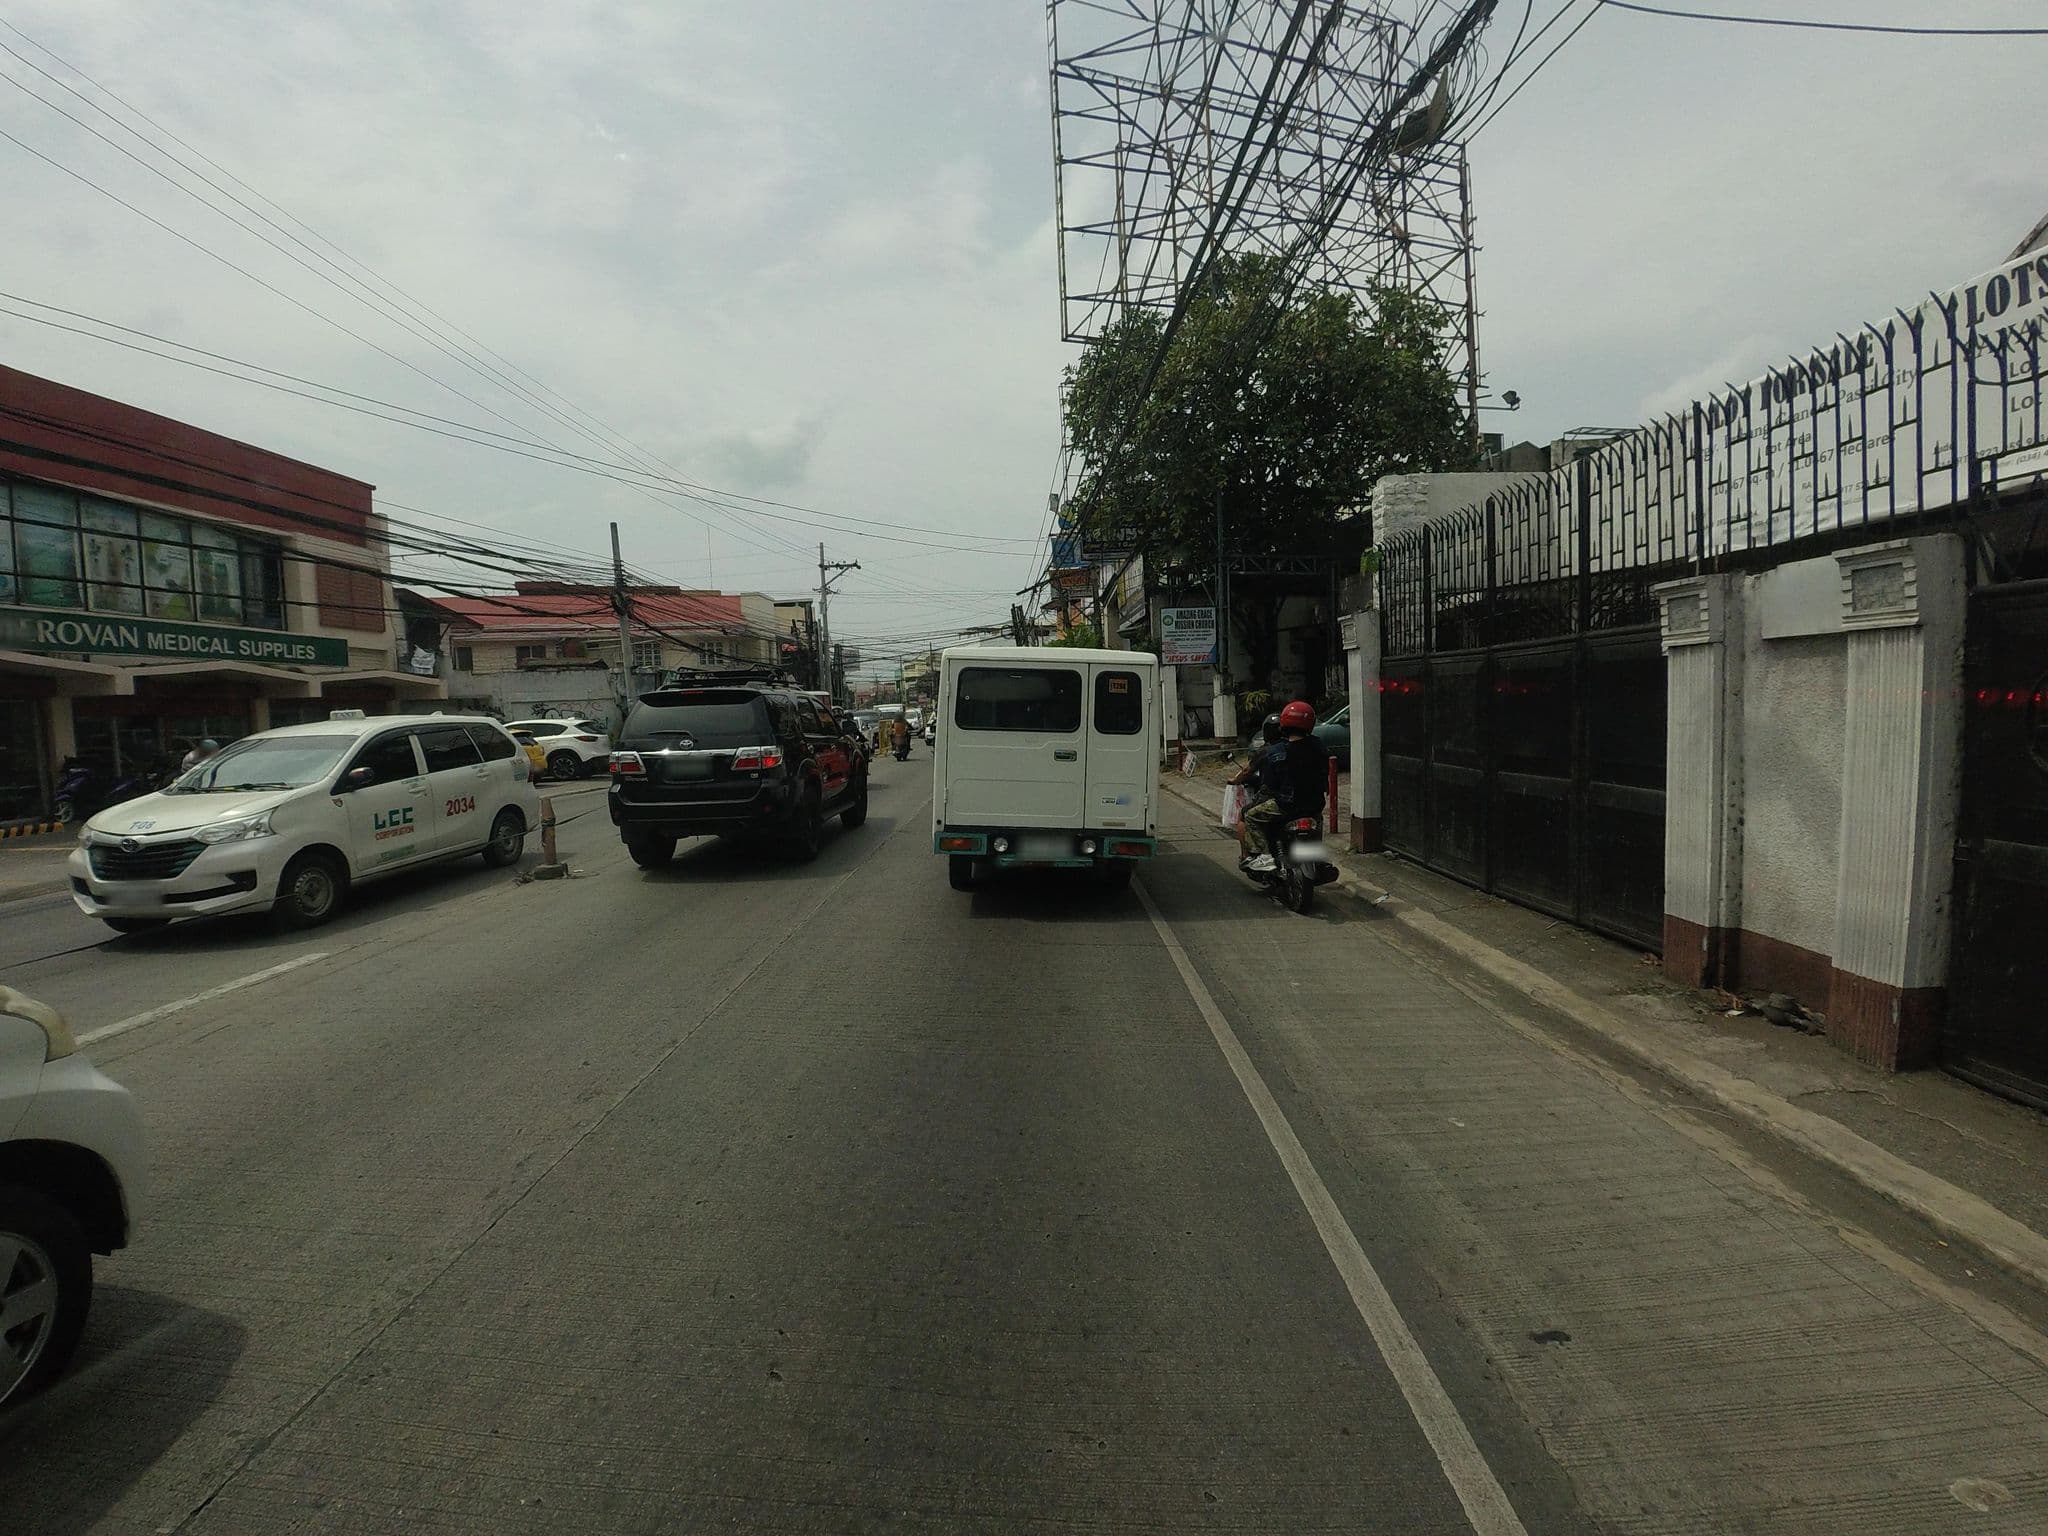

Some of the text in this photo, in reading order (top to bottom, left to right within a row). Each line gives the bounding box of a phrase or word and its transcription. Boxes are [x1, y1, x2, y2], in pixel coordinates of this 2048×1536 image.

[37, 619, 316, 660] ROVAN MEDICAL SUPPLIES
[446, 796, 476, 817] 2034
